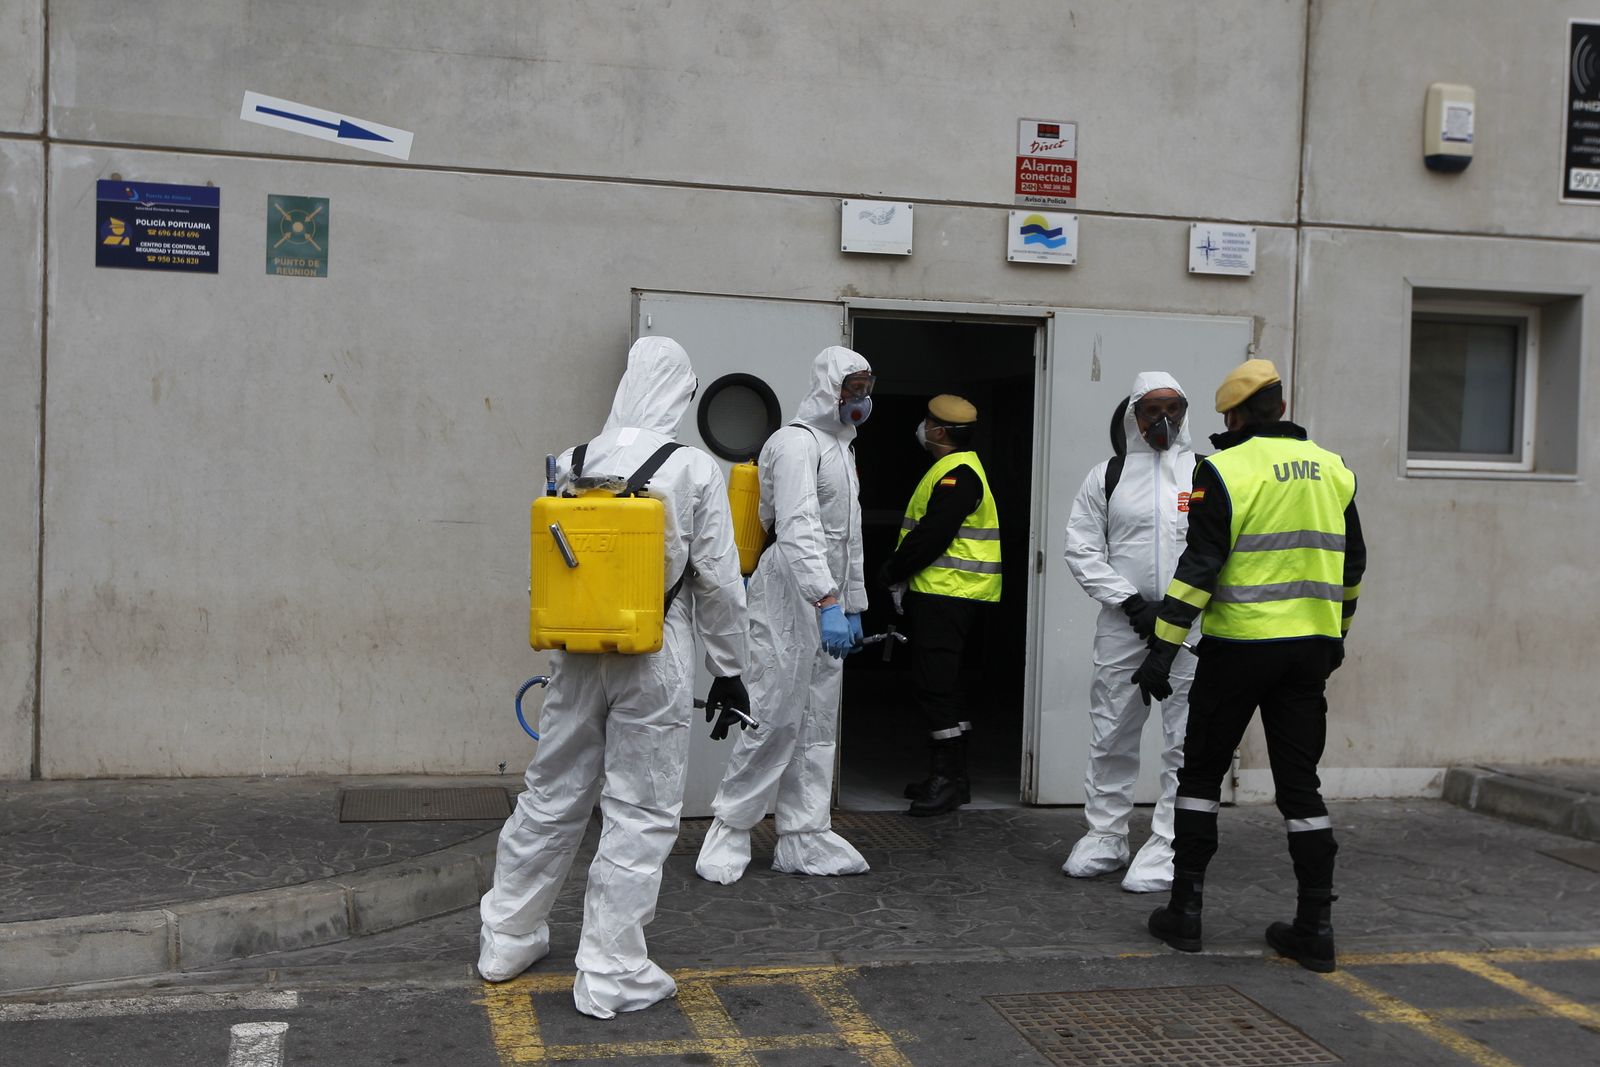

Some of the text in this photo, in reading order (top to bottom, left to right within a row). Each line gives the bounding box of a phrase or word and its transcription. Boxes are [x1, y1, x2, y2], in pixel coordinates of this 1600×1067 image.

[1030, 139, 1069, 153] Direct
[1021, 159, 1072, 173] Alarma
[1020, 172, 1072, 183] conectada
[136, 218, 211, 230] POLICÍA PORTUARIA
[274, 256, 320, 268] PUNTO DE
[1273, 460, 1321, 482] UME
